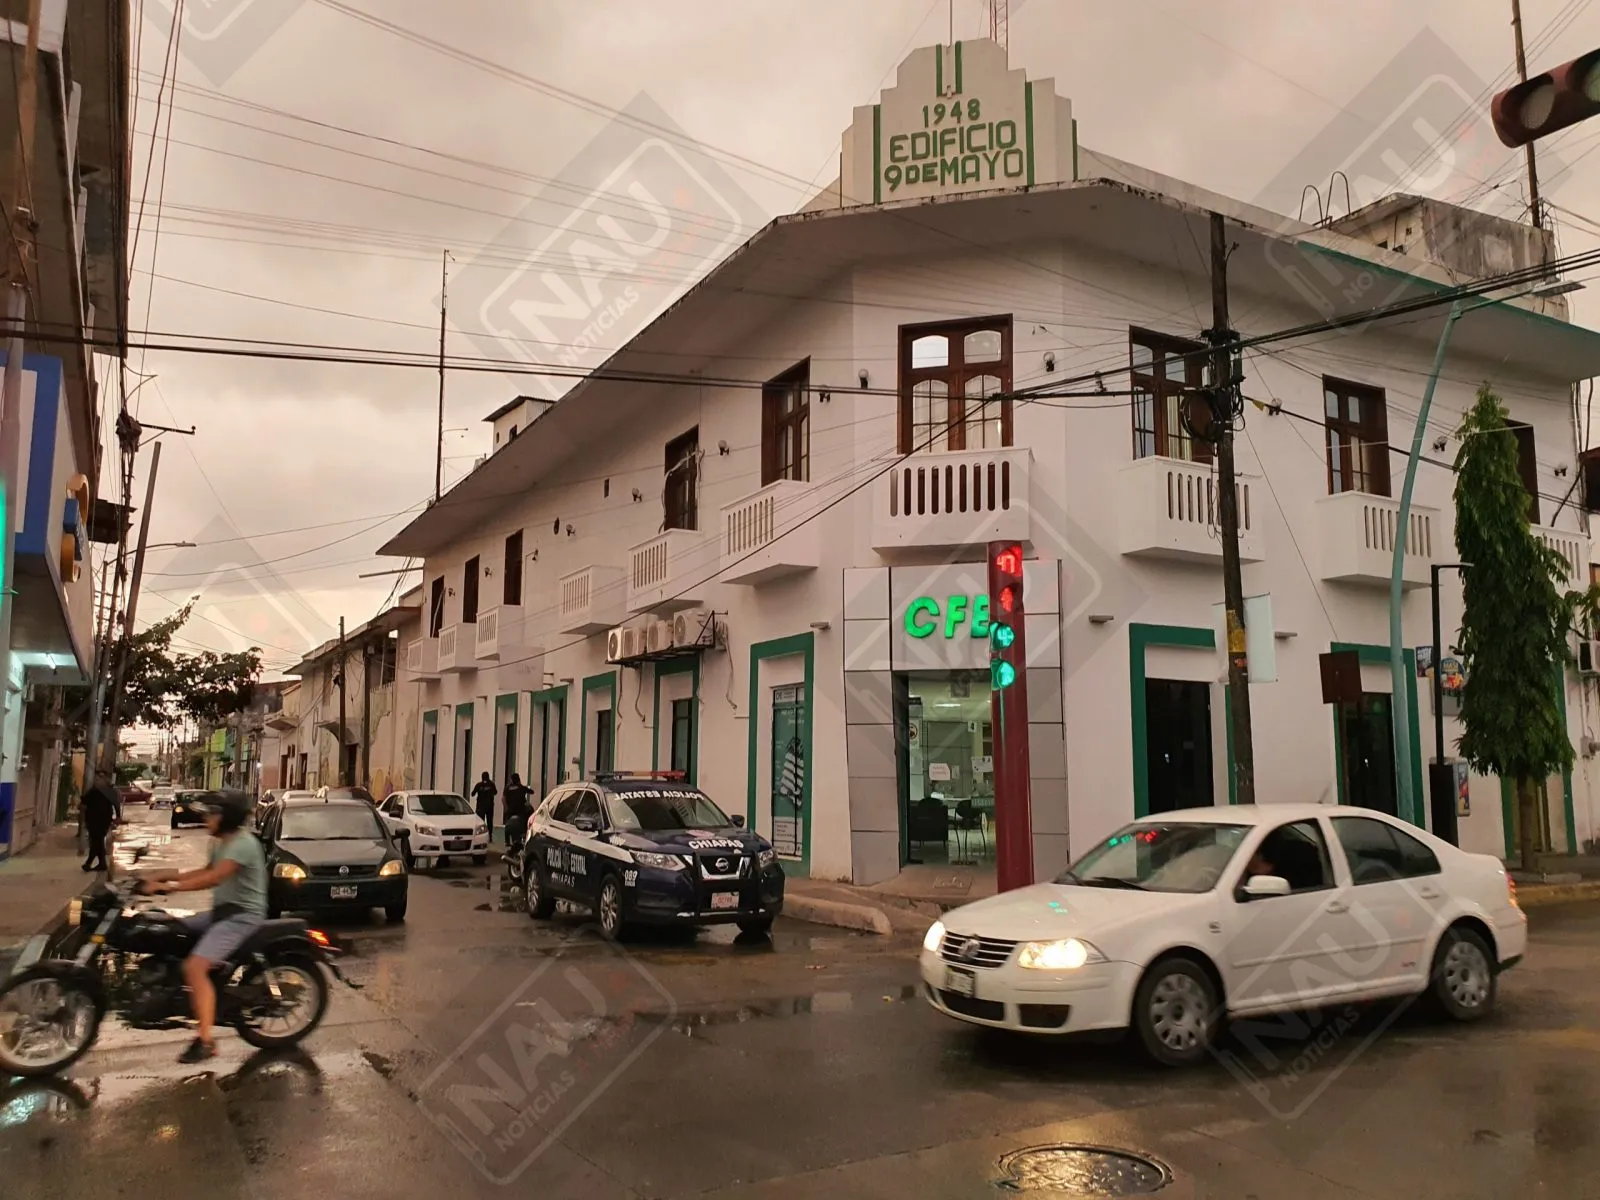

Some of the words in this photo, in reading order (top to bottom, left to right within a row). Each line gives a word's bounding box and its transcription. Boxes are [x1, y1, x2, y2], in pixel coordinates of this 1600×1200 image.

[922, 98, 981, 128] 1948
[889, 120, 1017, 163] EDIFICIO
[904, 594, 989, 639] CFE
[688, 839, 744, 849] CHIAPAS
